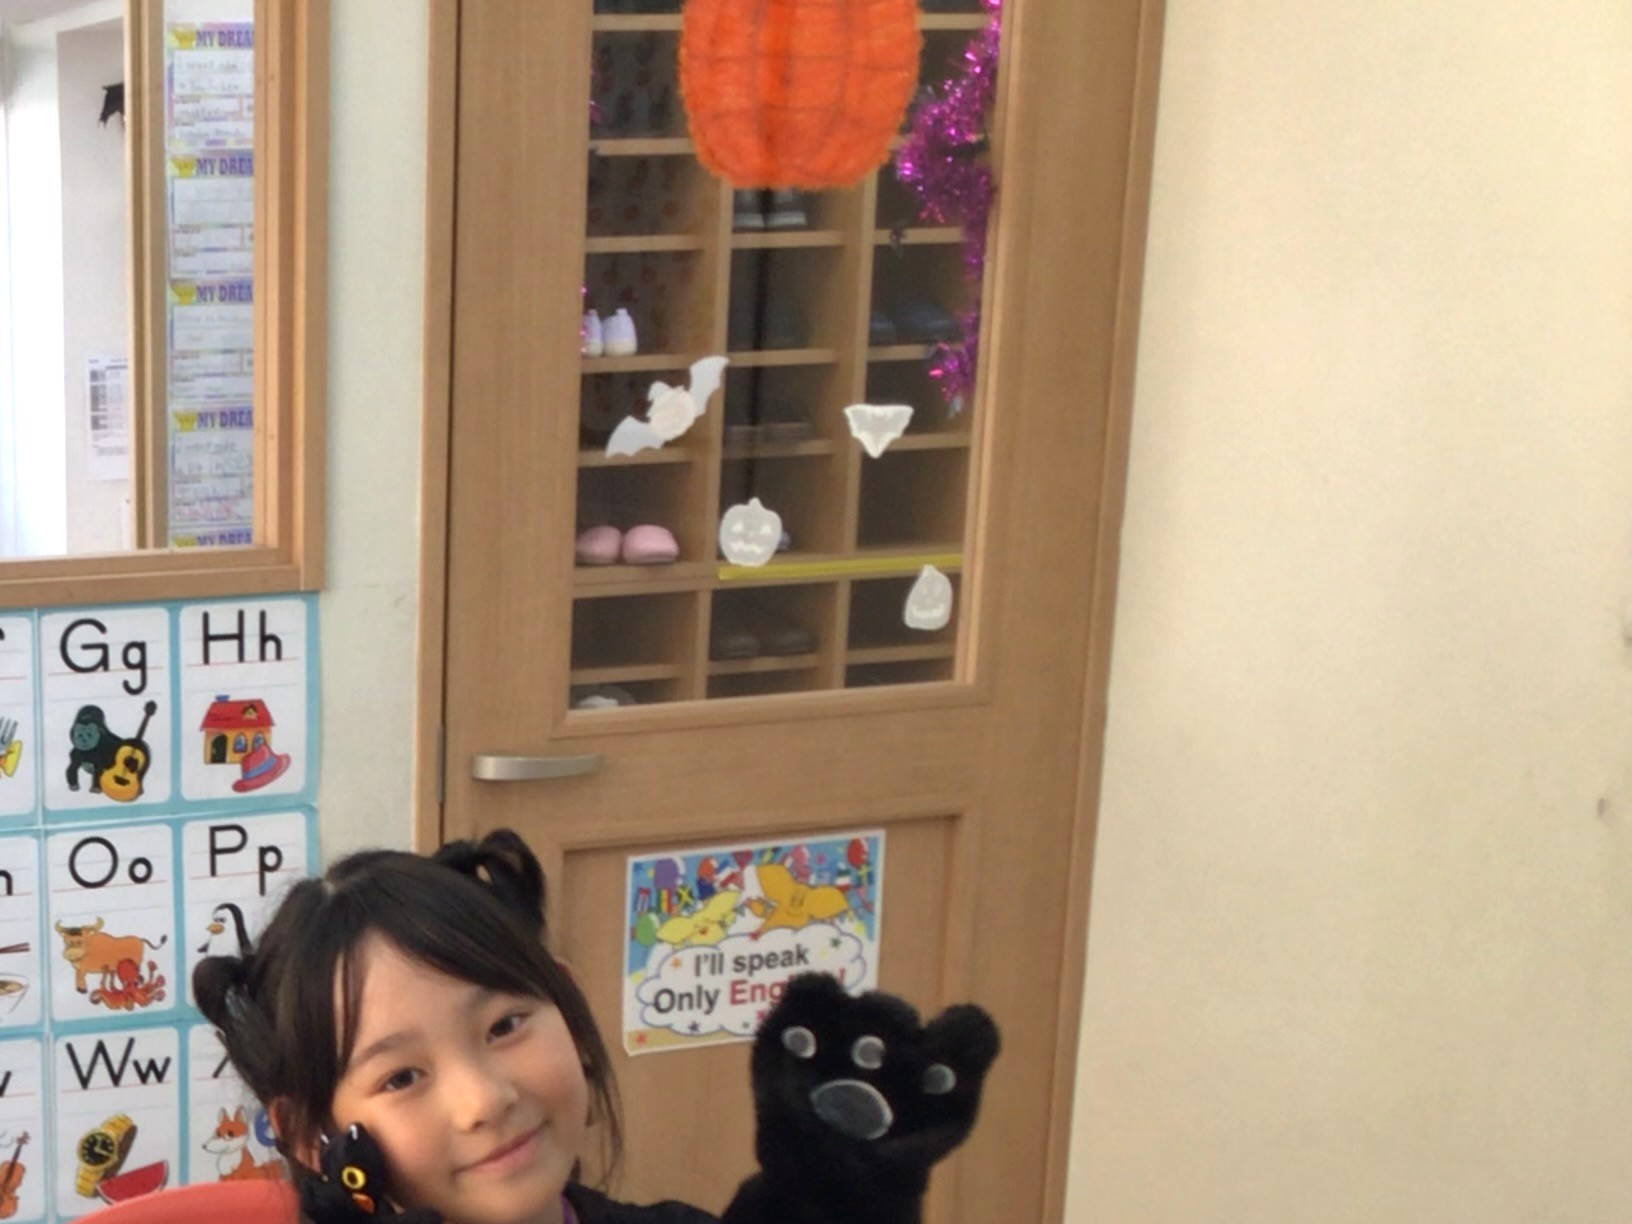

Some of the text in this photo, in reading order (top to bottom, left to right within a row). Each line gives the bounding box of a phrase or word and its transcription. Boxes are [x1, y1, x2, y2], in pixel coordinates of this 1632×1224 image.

[60, 618, 148, 696] Gg
[202, 609, 283, 665] Hh
[68, 836, 153, 889] Oo
[209, 824, 283, 896] Pp
[695, 944, 809, 977] I'll speak
[653, 985, 719, 1014] Only
[66, 1037, 171, 1090] Ww
